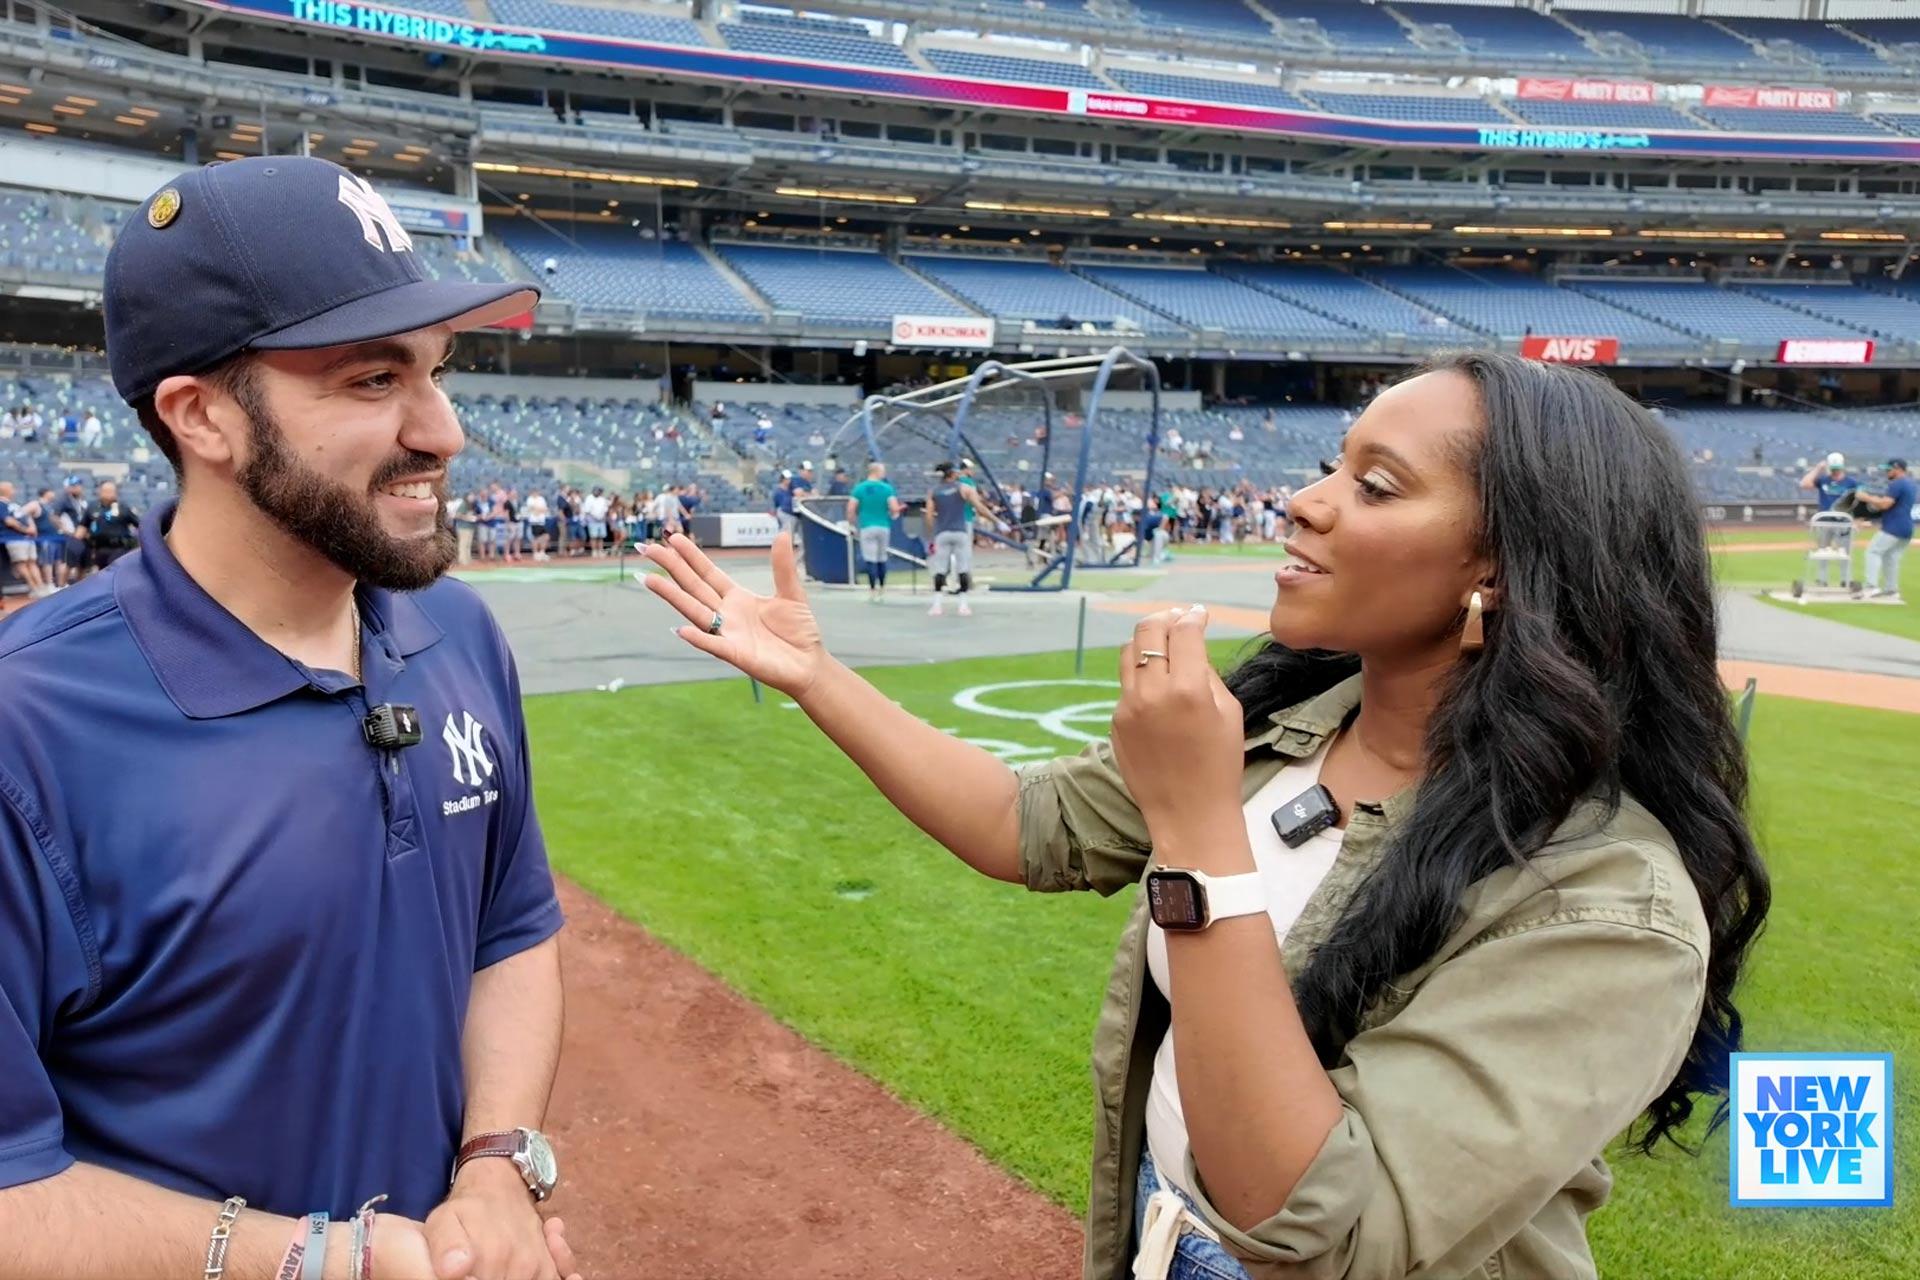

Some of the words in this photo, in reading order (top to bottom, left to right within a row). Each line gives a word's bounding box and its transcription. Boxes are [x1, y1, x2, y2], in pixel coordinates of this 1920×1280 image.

[291, 0, 352, 28] THIS
[356, 8, 474, 48] HYBRID'S
[1756, 89, 1796, 107] PARTY
[1797, 91, 1832, 108] DECK
[1478, 128, 1519, 147] THIS
[1519, 129, 1600, 149] HYBRID'S
[1541, 339, 1596, 361] AVIS
[442, 710, 494, 786] NY
[443, 795, 481, 816] Stadium
[1150, 877, 1163, 905] 5:46
